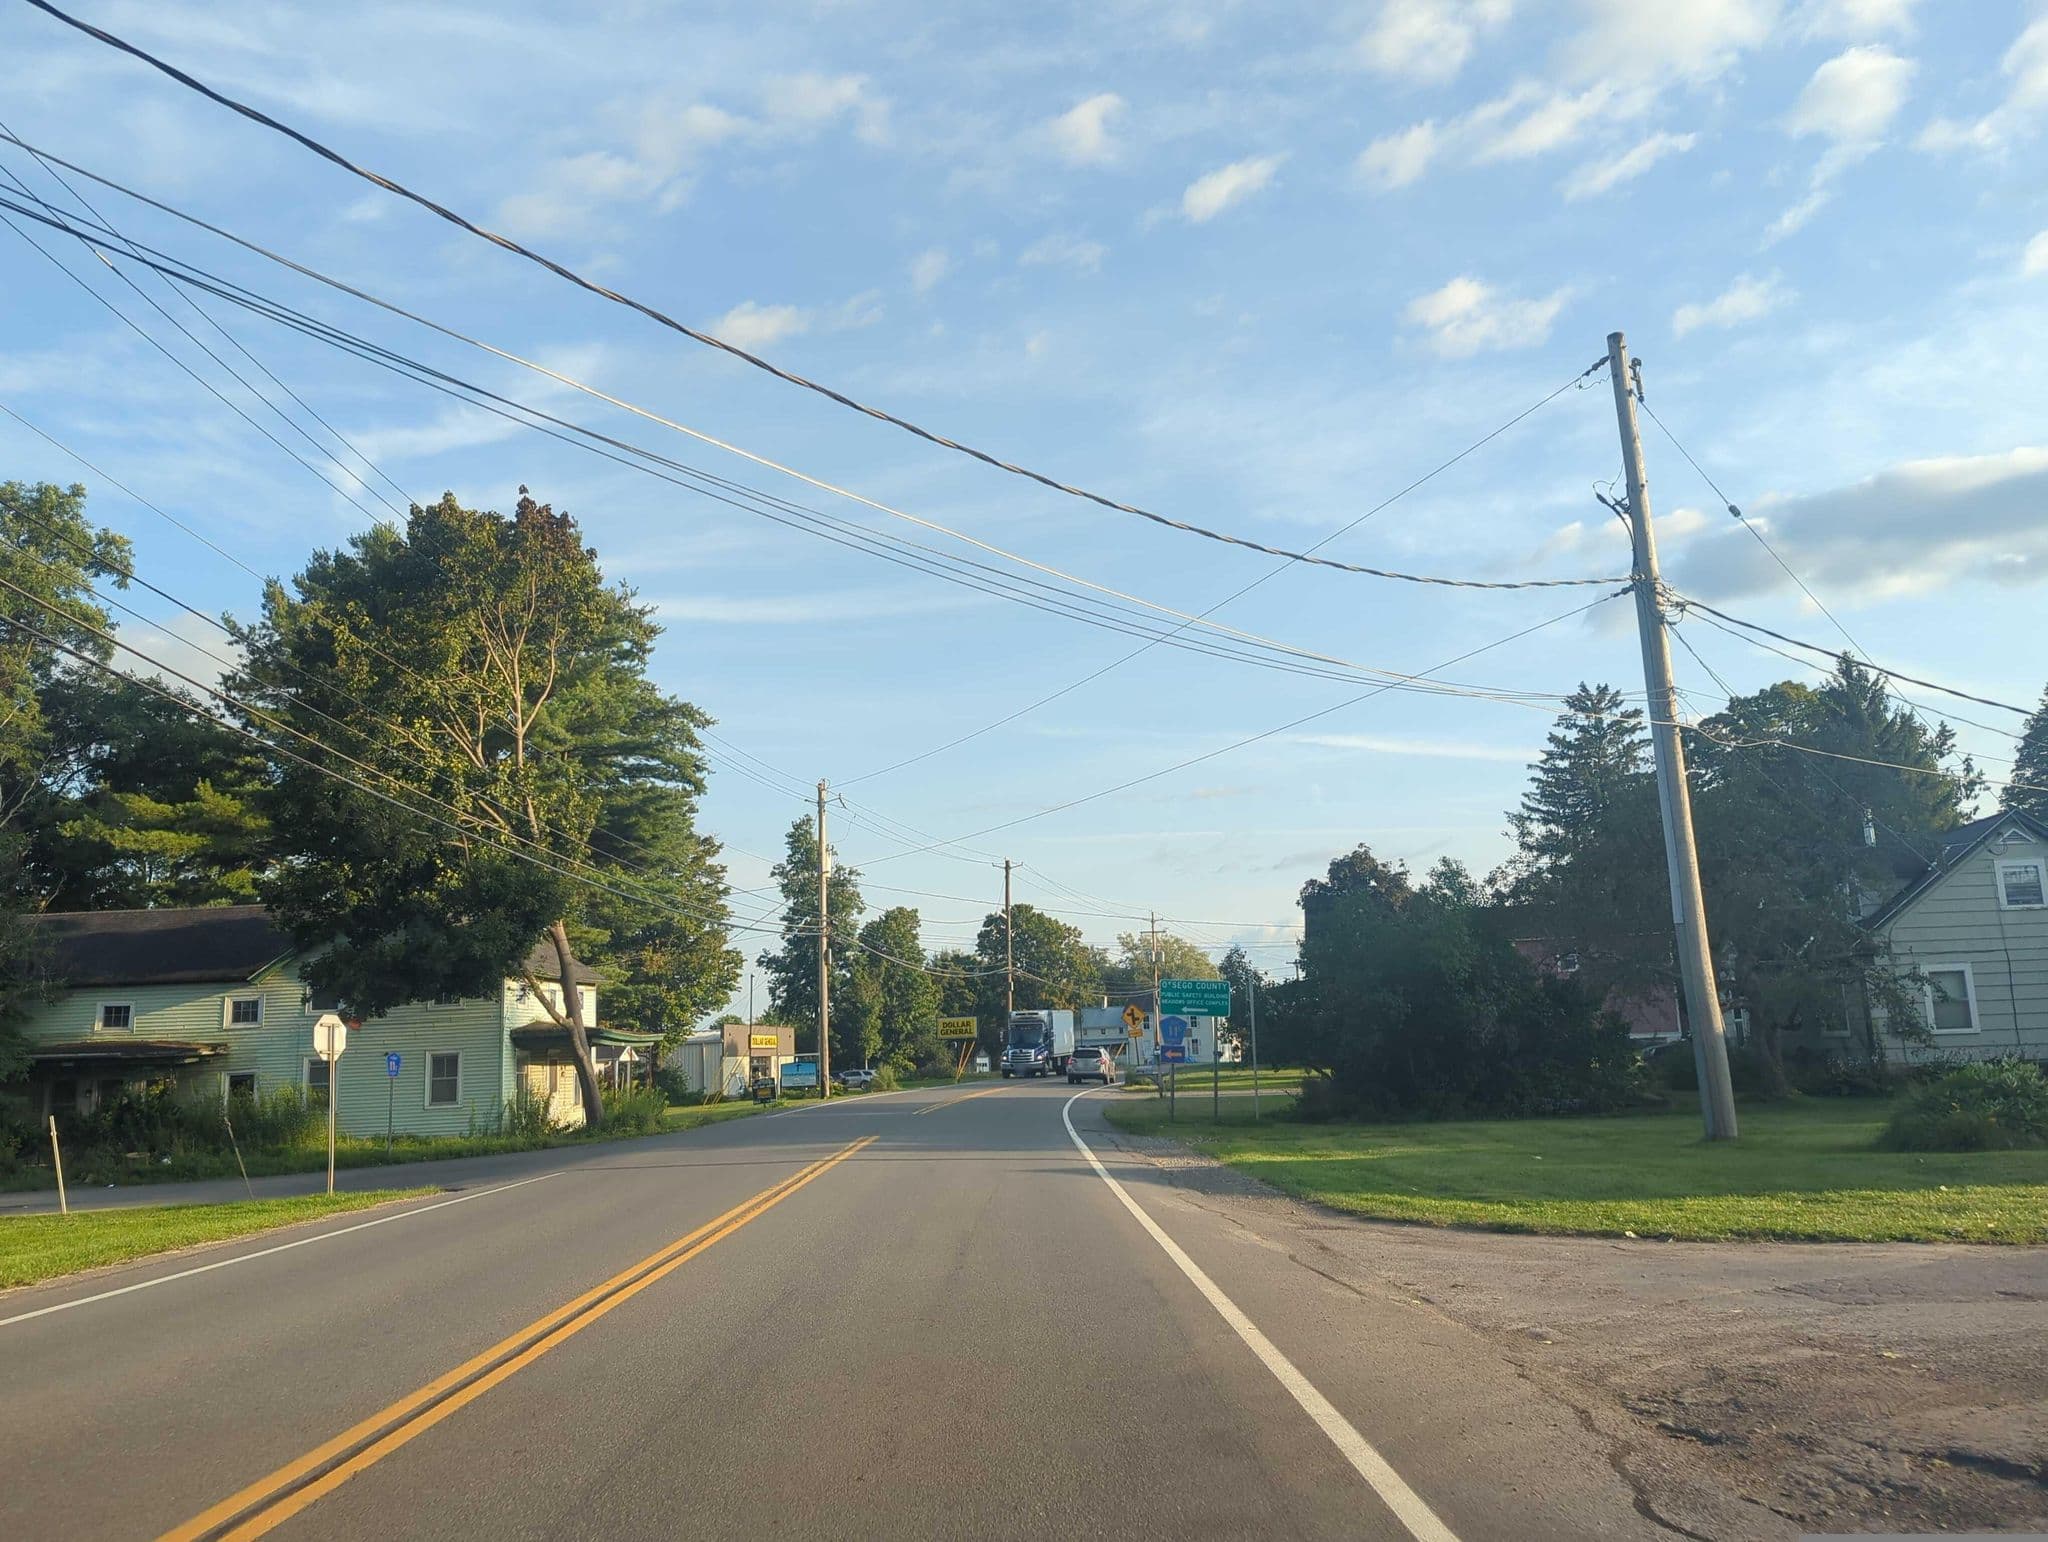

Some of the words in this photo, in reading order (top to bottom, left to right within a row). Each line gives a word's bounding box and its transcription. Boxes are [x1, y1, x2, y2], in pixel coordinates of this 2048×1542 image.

[1195, 982, 1228, 990] COUNTY
[942, 1020, 971, 1029] DOLLAR
[940, 1028, 974, 1036] GENERAL
